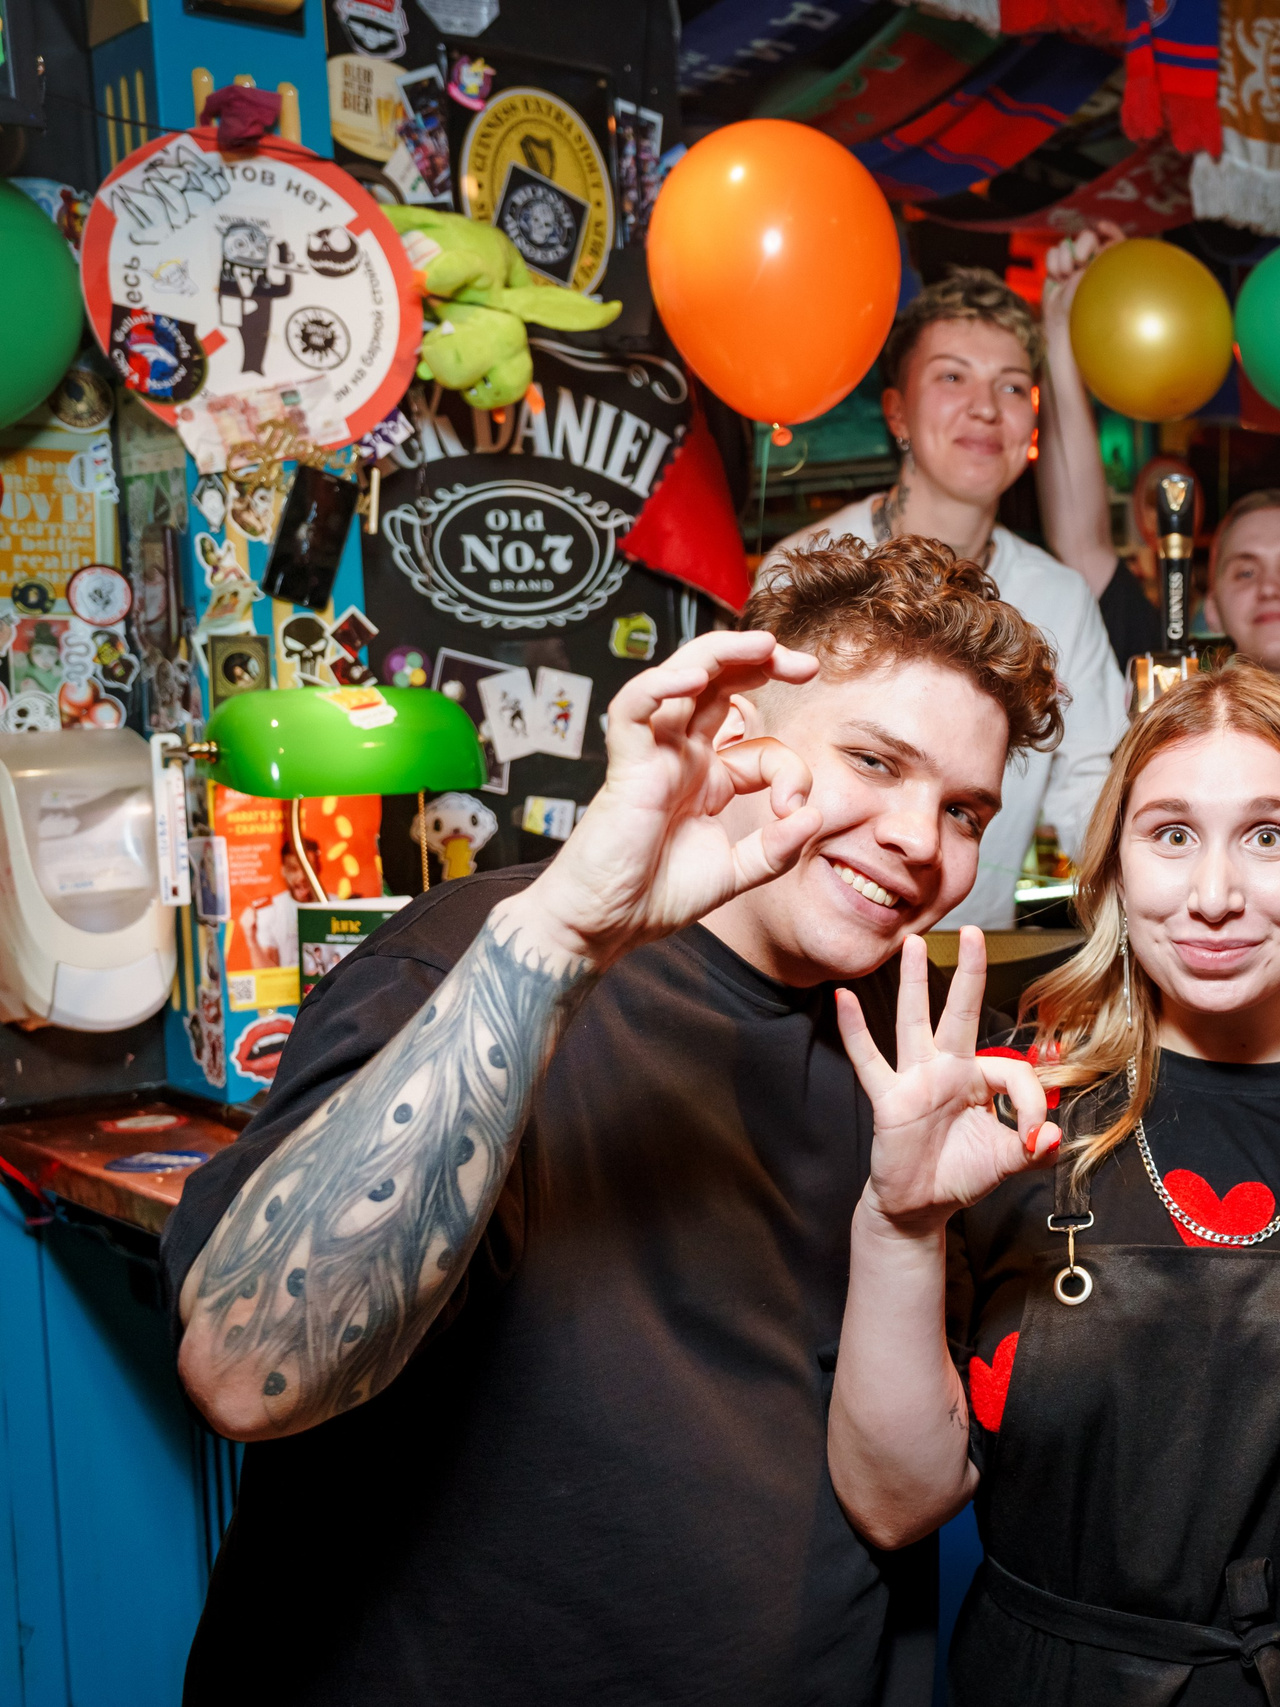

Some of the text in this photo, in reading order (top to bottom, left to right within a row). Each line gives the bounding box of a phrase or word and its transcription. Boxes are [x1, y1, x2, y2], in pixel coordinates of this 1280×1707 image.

[485, 509, 545, 531] Old
[459, 534, 574, 574] No.7
[489, 579, 554, 593] BRAND
[1167, 571, 1184, 640] GUINNESS
